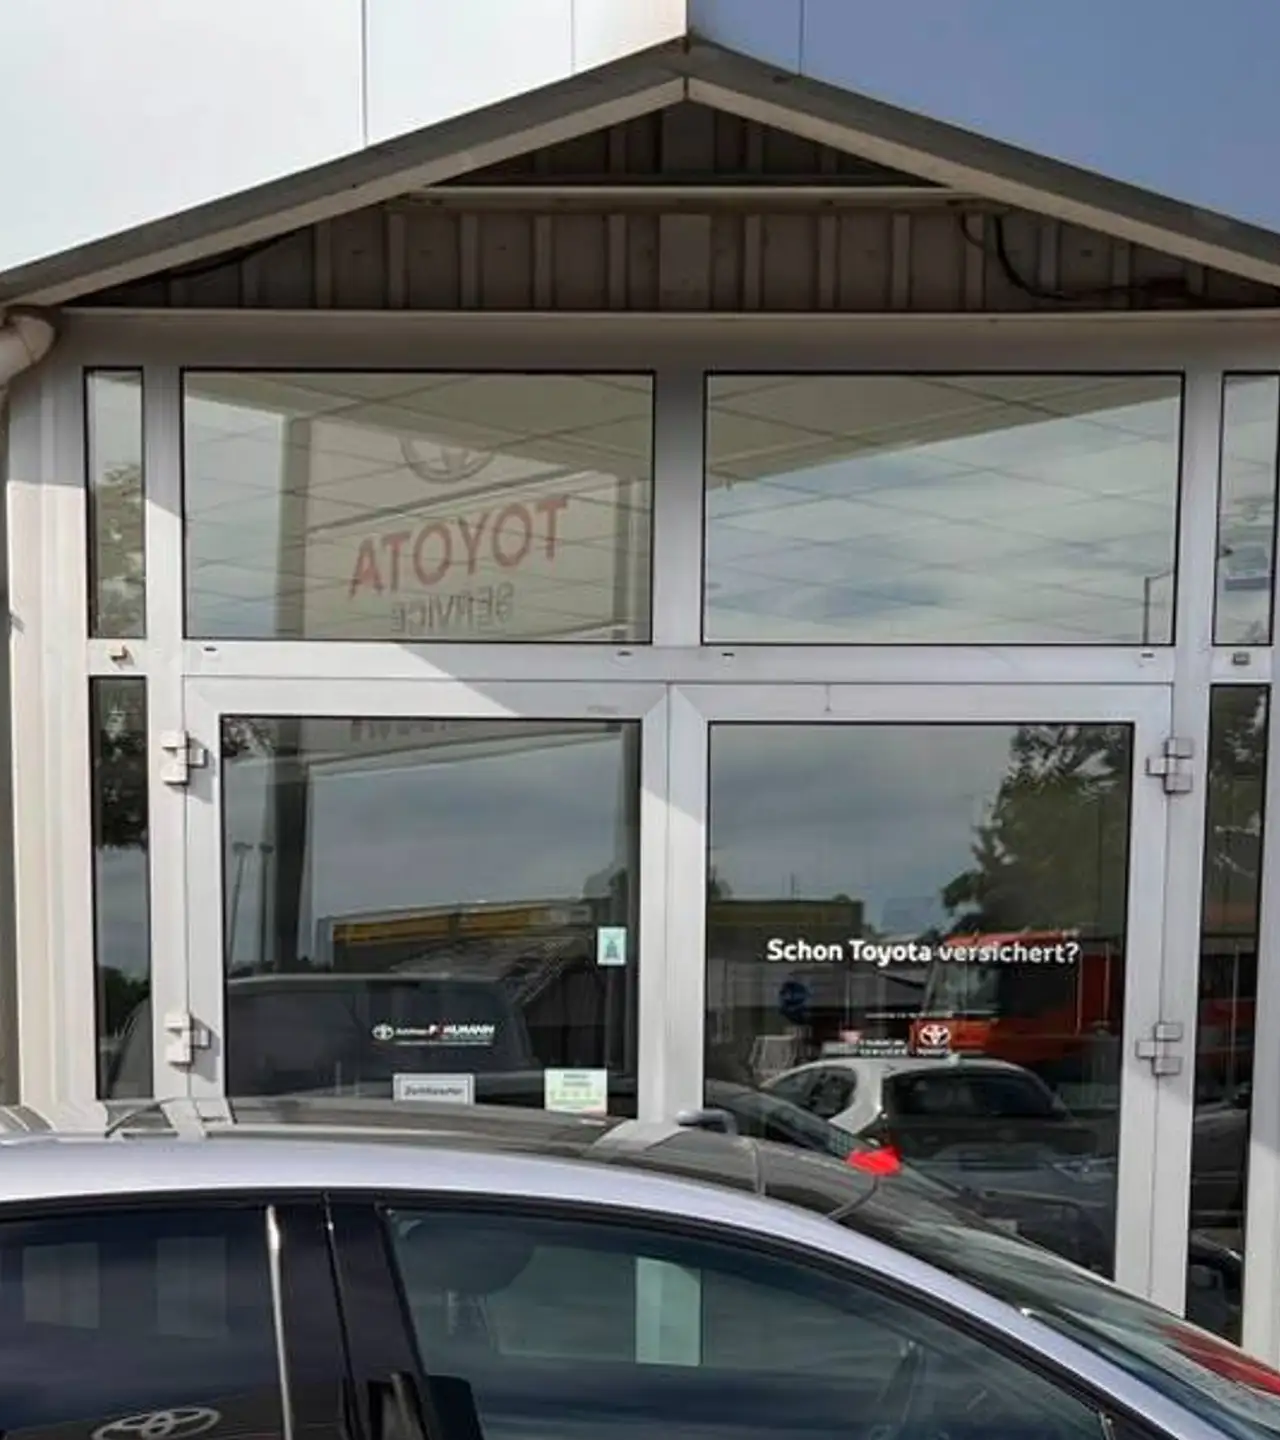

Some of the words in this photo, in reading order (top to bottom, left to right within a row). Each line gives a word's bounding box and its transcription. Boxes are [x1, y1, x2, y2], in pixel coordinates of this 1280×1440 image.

[767, 937, 843, 962] Schon
[849, 939, 933, 967] Toyota
[939, 941, 1079, 964] versichert?
